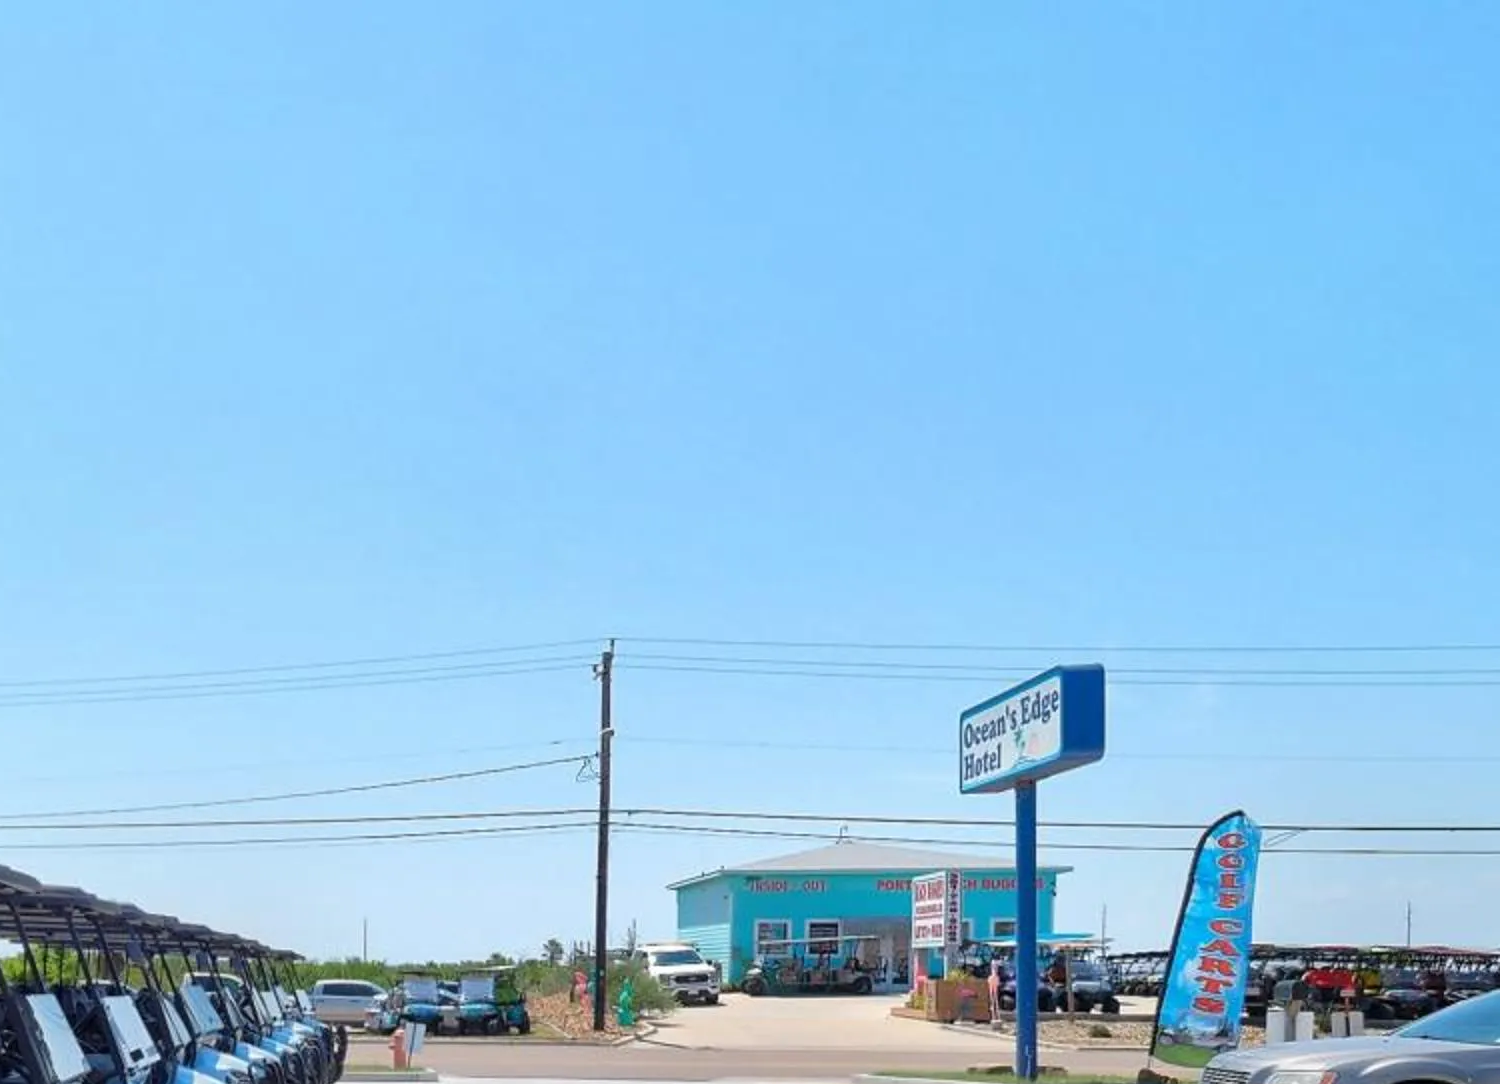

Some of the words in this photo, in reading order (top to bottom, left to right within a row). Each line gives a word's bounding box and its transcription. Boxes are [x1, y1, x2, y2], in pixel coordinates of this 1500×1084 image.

[963, 705, 1017, 749] Ocean's
[1020, 689, 1059, 724] Edge
[963, 743, 1001, 781] Hotel
[1215, 831, 1249, 910] GOLF
[1191, 918, 1246, 1015] CARTS
